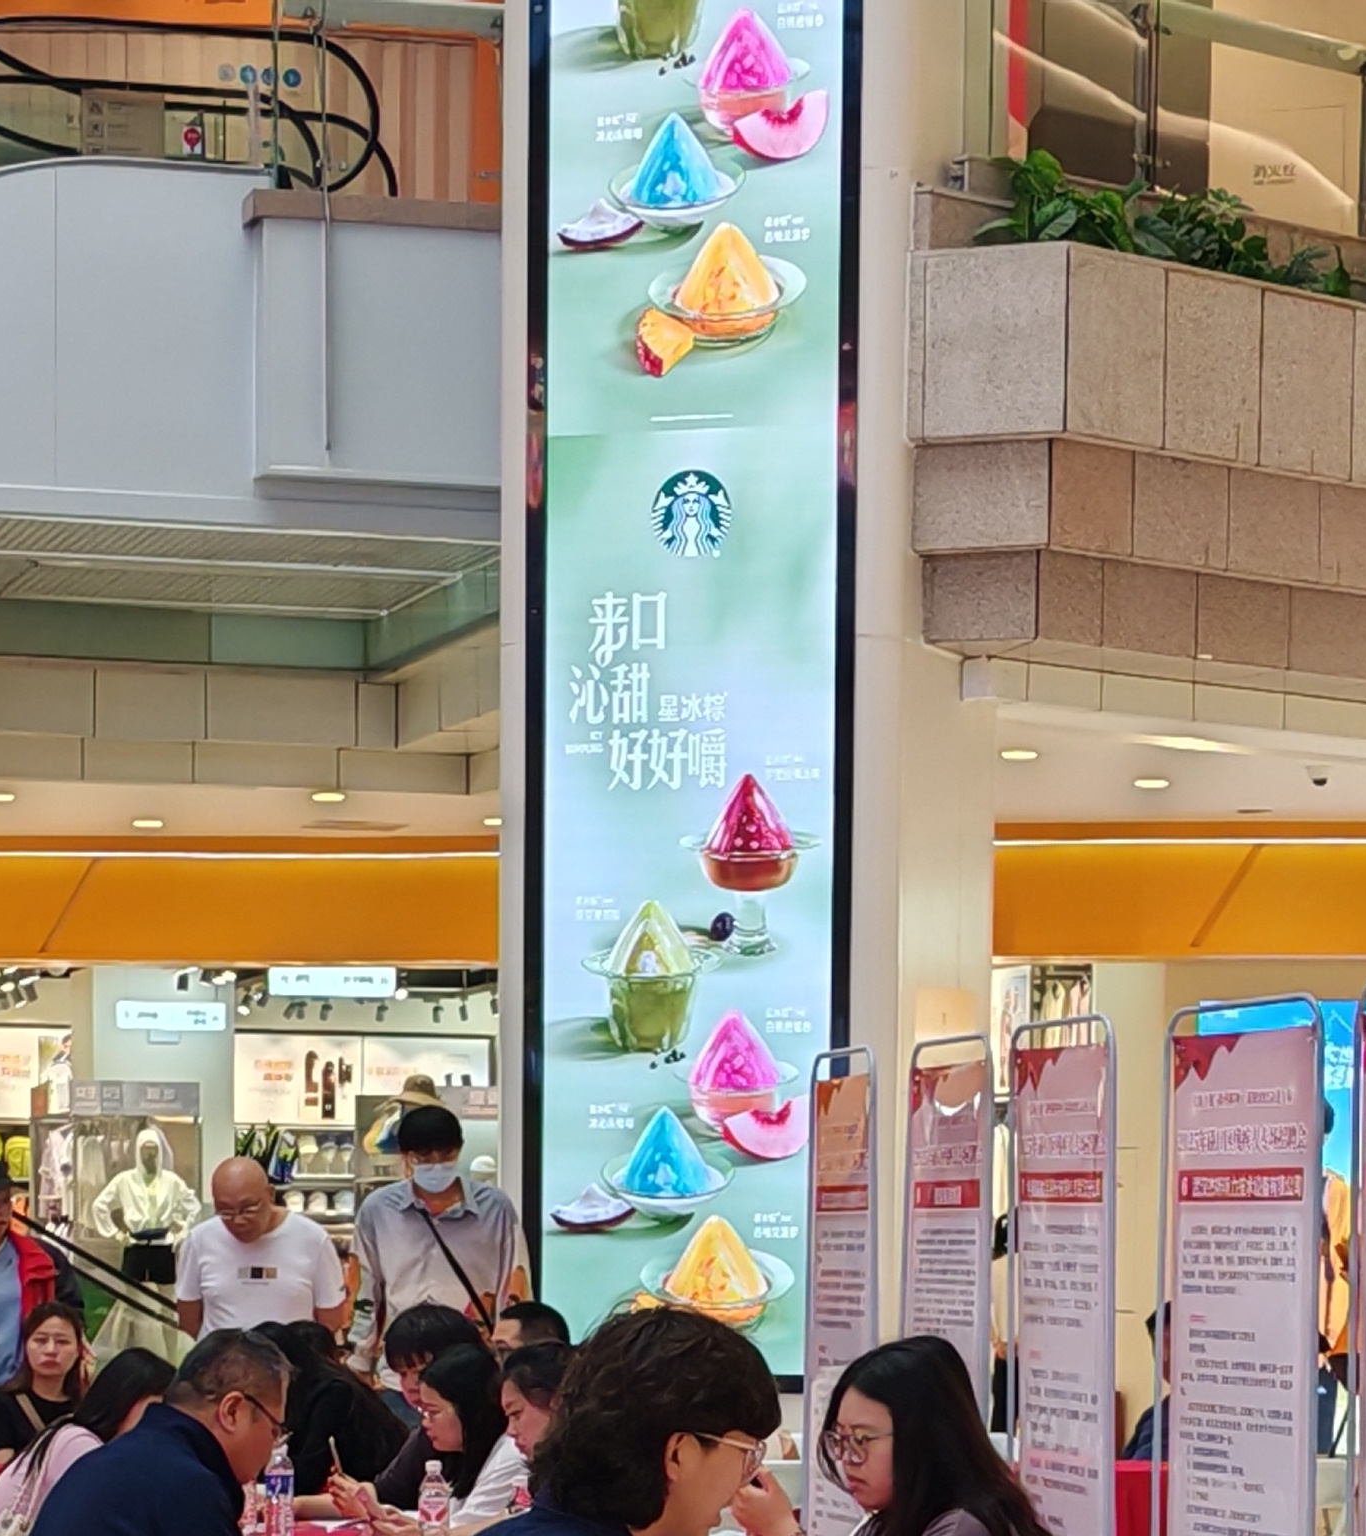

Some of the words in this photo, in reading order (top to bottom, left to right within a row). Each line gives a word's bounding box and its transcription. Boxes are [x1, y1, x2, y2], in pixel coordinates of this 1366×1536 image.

[569, 662, 650, 724] 沁甜
[658, 692, 728, 722] 星冰粽
[608, 728, 727, 791] 好好嚼
